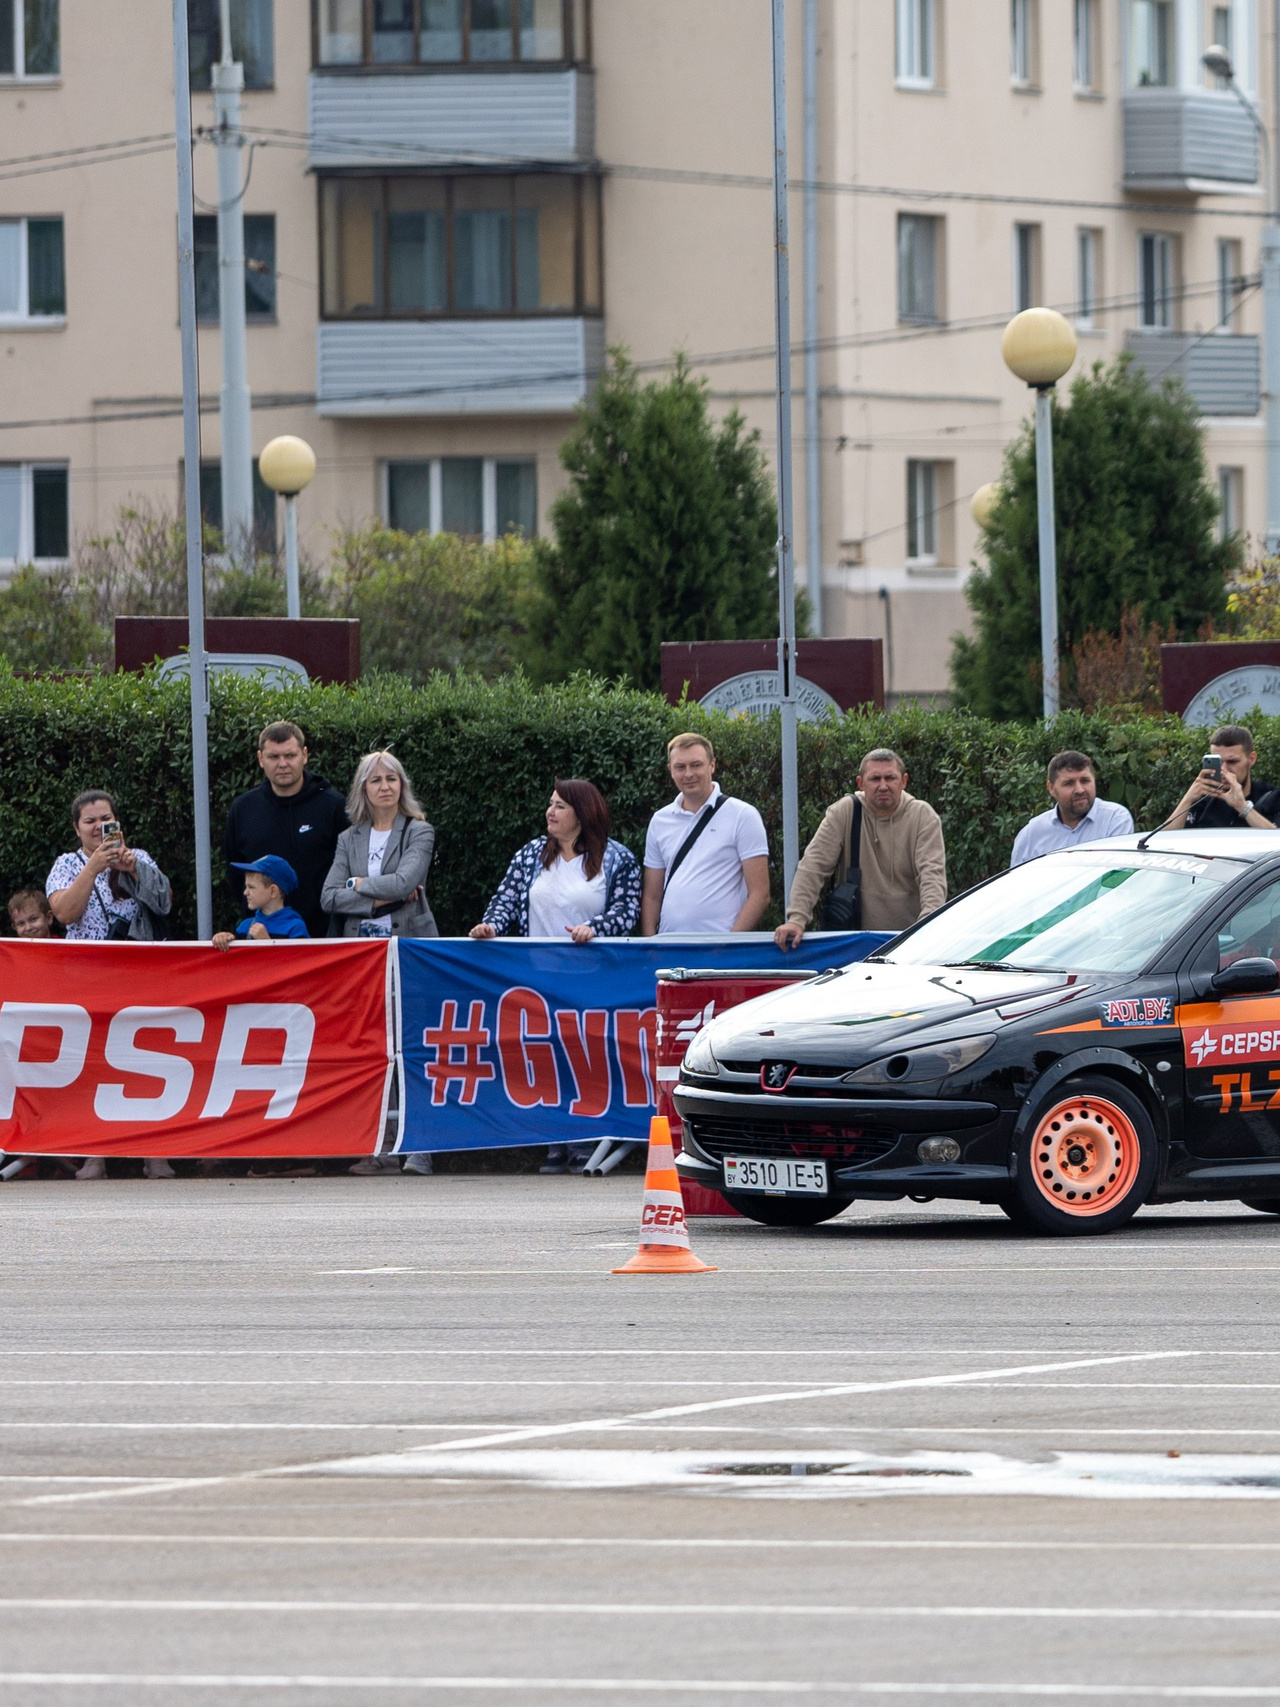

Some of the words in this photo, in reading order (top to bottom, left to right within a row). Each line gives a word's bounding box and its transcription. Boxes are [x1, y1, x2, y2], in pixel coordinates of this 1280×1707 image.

[1108, 997, 1167, 1022] ADT.BY
[727, 1173, 736, 1184] BY
[739, 1161, 778, 1186] 3510
[786, 1163, 824, 1189] IE-5
